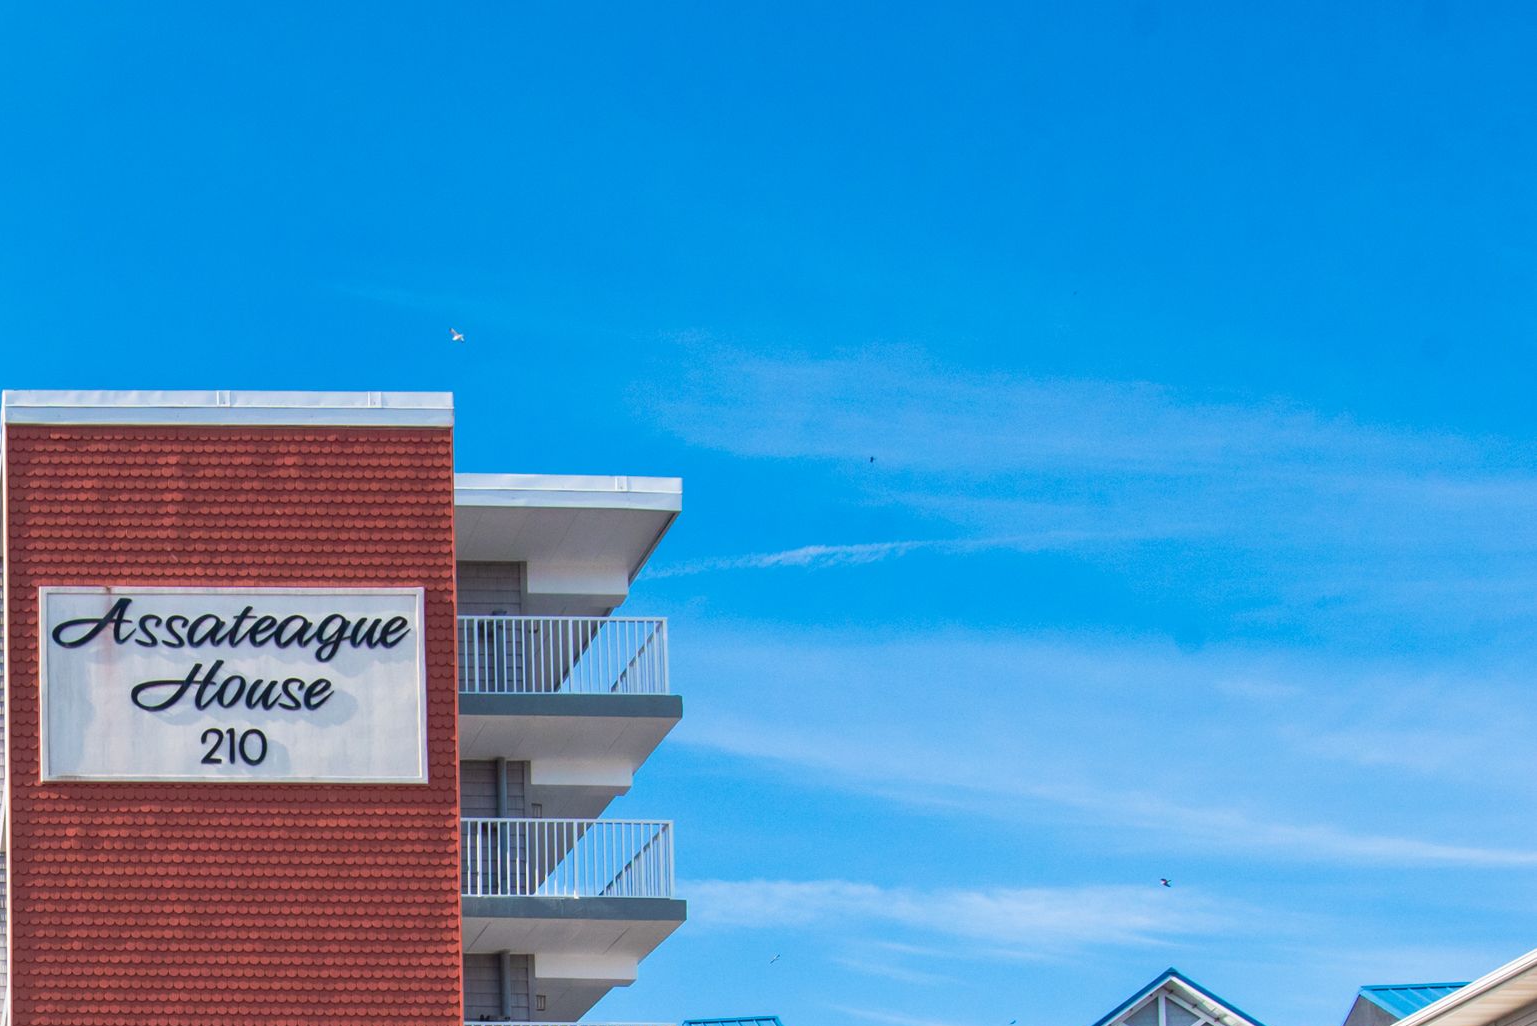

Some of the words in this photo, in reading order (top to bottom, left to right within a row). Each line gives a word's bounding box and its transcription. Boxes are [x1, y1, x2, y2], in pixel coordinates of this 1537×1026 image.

[52, 598, 411, 662] Assateague
[131, 660, 334, 711] House
[200, 728, 268, 766] 210
